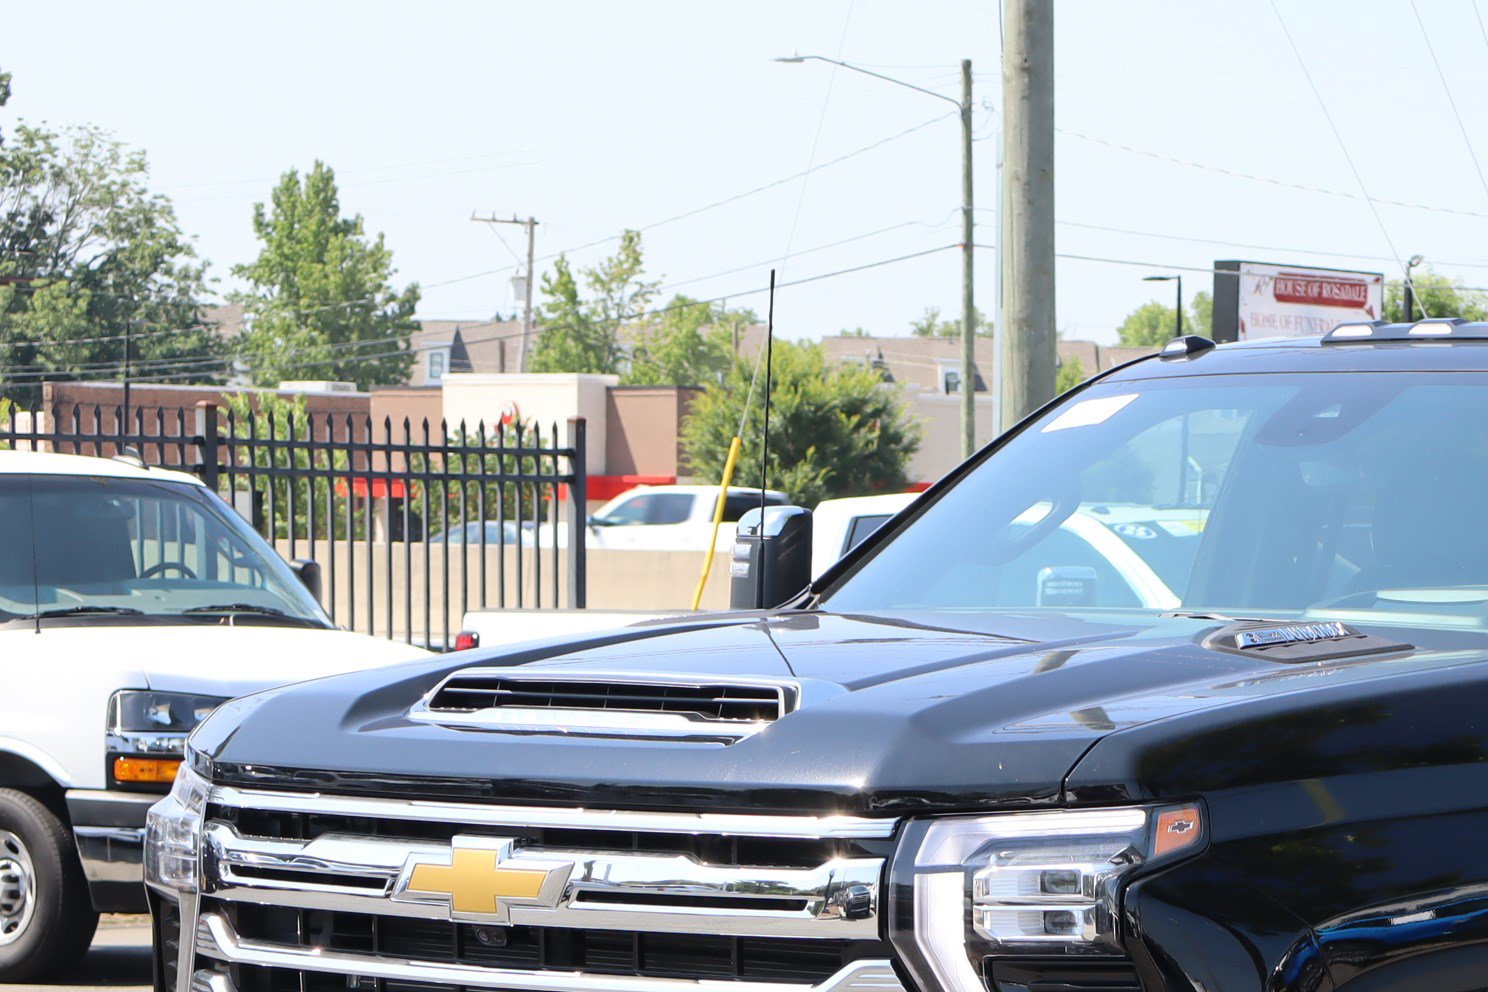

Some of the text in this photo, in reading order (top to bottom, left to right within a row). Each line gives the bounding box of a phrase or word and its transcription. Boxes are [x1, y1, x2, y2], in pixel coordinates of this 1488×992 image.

[1275, 278, 1367, 303] HOUSE OF ROSADALE
